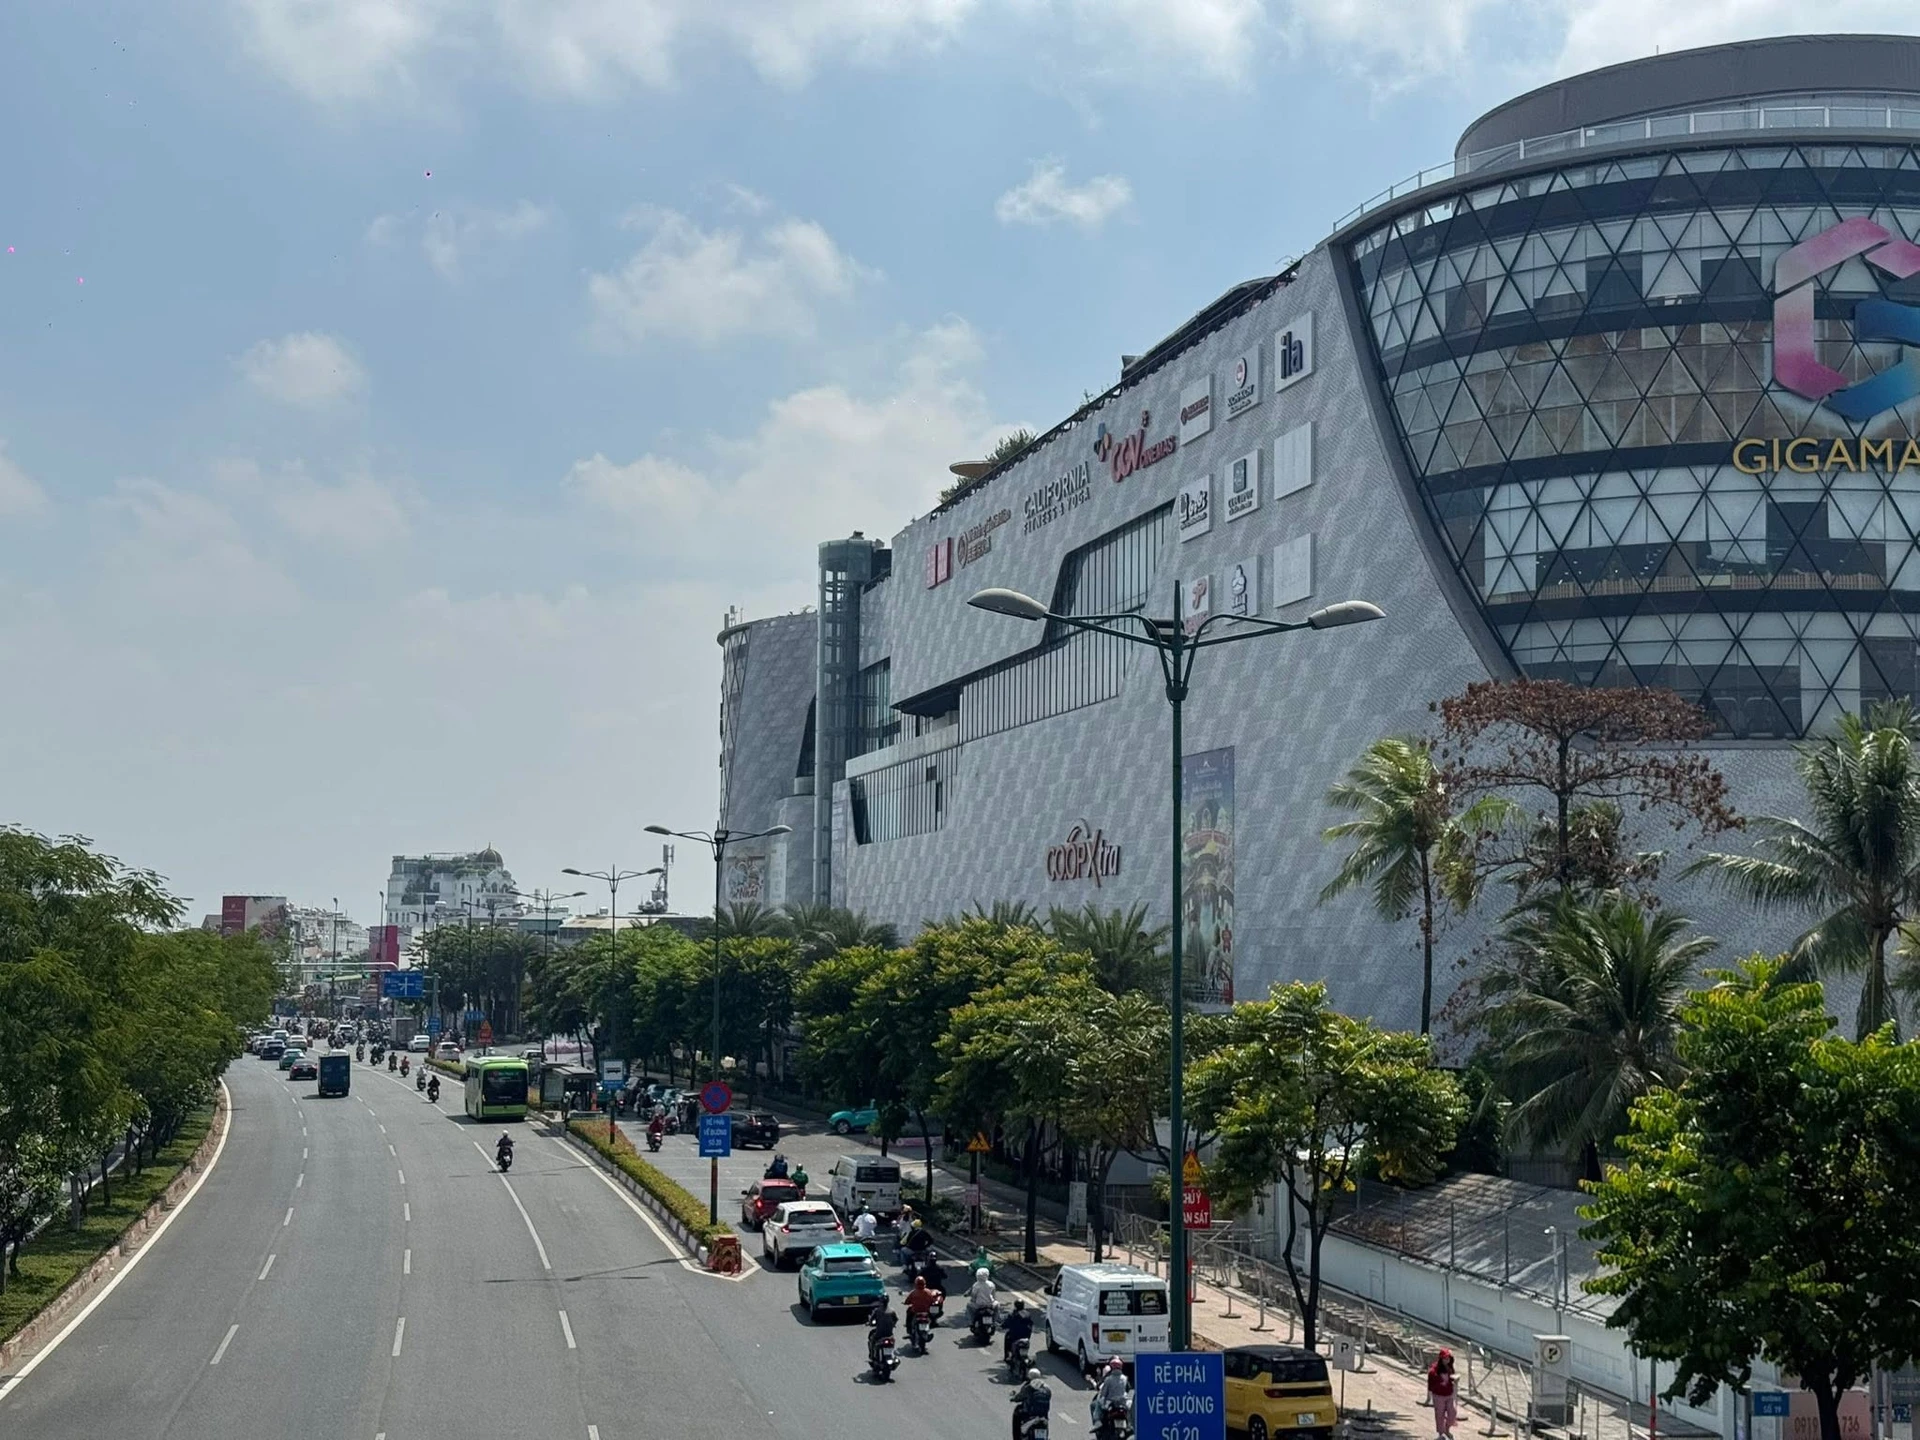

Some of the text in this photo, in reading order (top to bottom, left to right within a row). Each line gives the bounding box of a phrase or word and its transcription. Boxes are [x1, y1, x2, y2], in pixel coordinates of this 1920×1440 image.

[1280, 330, 1303, 379] ila
[1111, 428, 1177, 483] CGV CINEMAS
[1732, 437, 1920, 475] GIGAMA
[1024, 460, 1090, 519] CALIFORNIA
[1023, 505, 1058, 536] FITNESS
[1067, 487, 1091, 511] YOGA
[1193, 1209, 1209, 1224] SÁT
[1154, 1359, 1206, 1383] RẼ PHẢI
[1147, 1389, 1214, 1414] VỀ ĐƯỜNG
[1162, 1420, 1199, 1440] SỐ 20
[1842, 1415, 1860, 1433] 736
